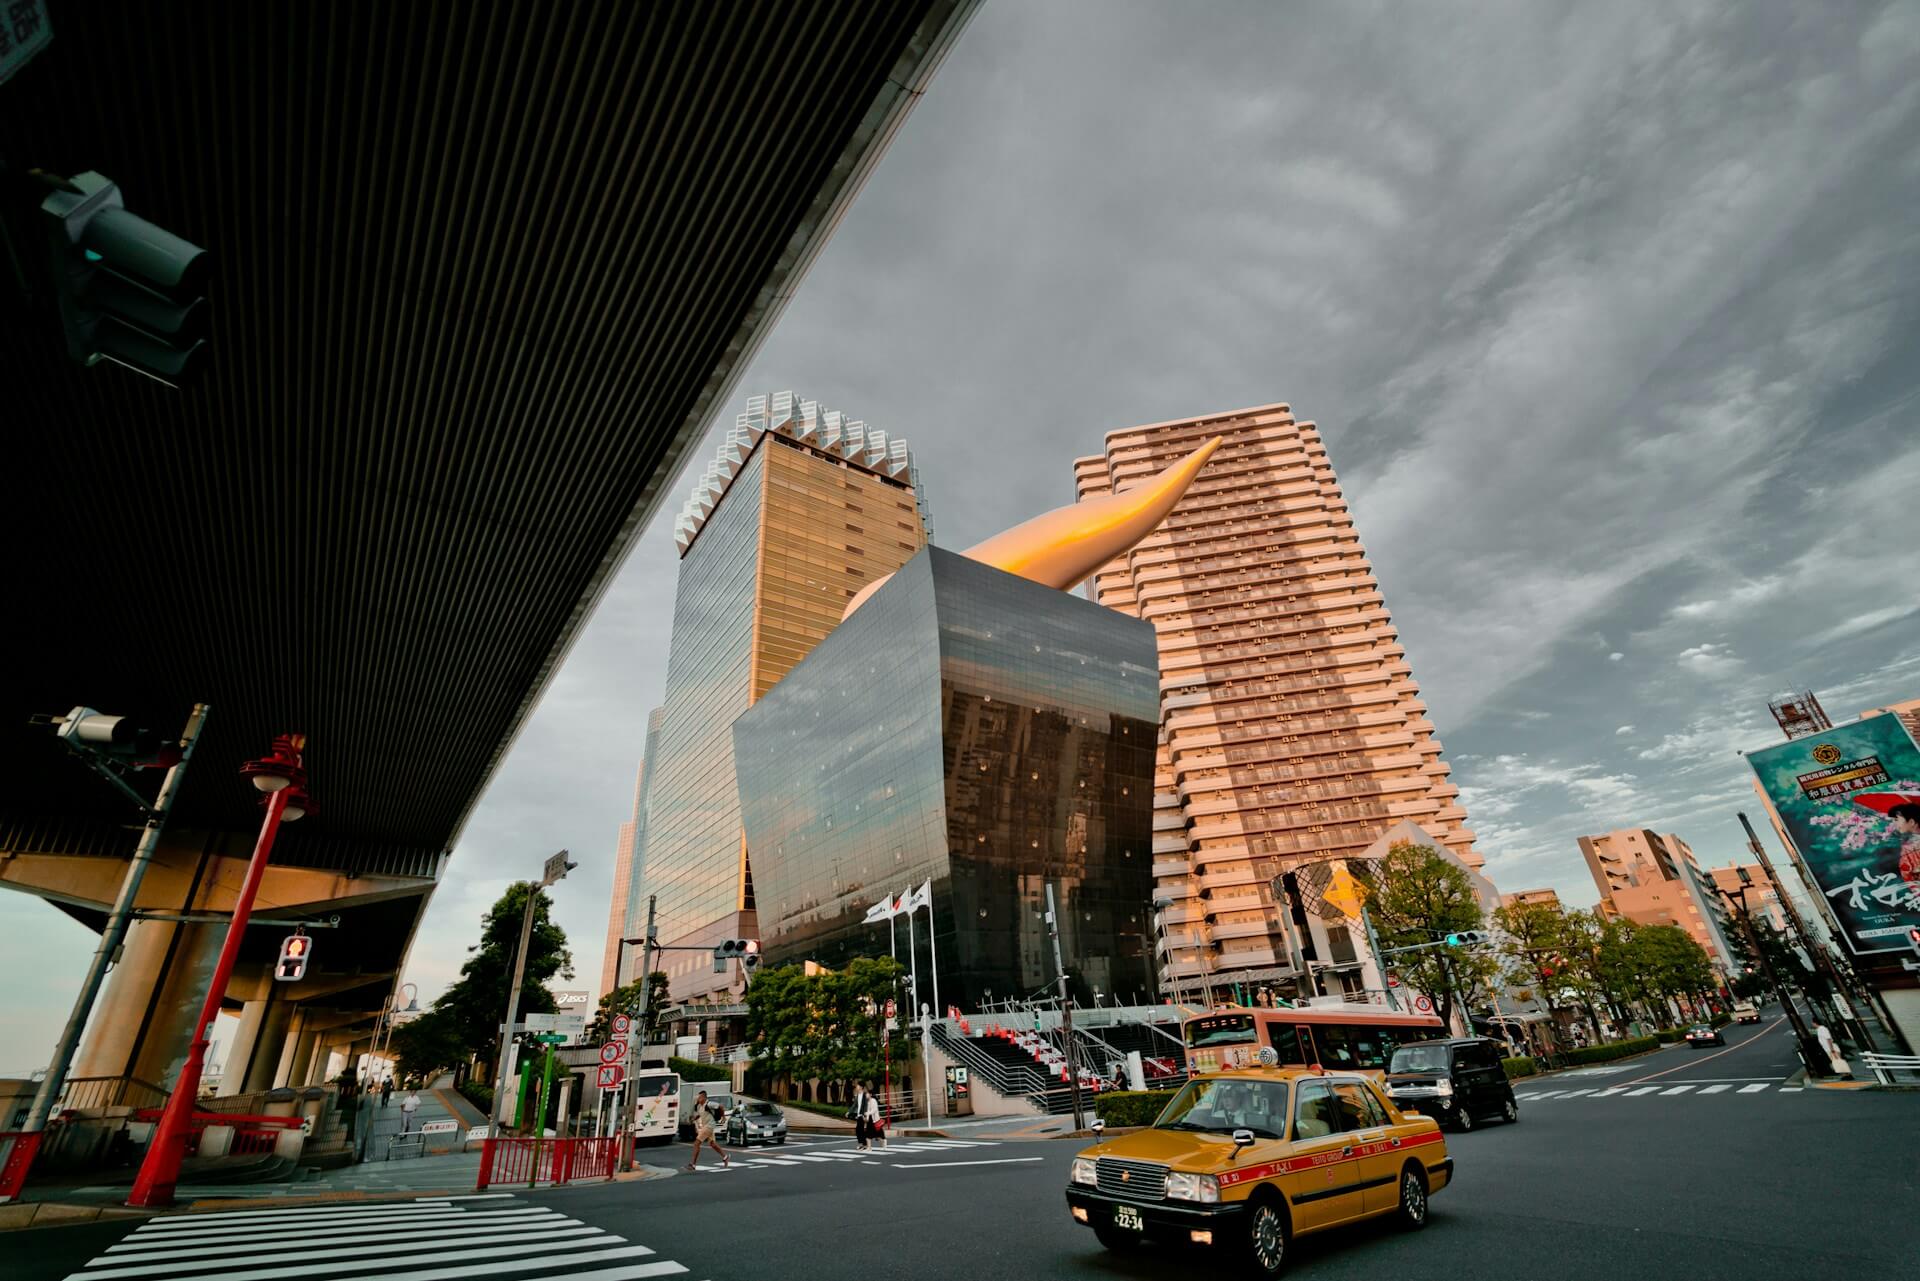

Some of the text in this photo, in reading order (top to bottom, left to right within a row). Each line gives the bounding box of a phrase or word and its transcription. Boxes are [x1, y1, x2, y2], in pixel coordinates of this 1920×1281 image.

[616, 1019, 626, 1029] 30
[1311, 1151, 1344, 1165] TEITO GROUP
[1269, 1160, 1293, 1173] TAXI
